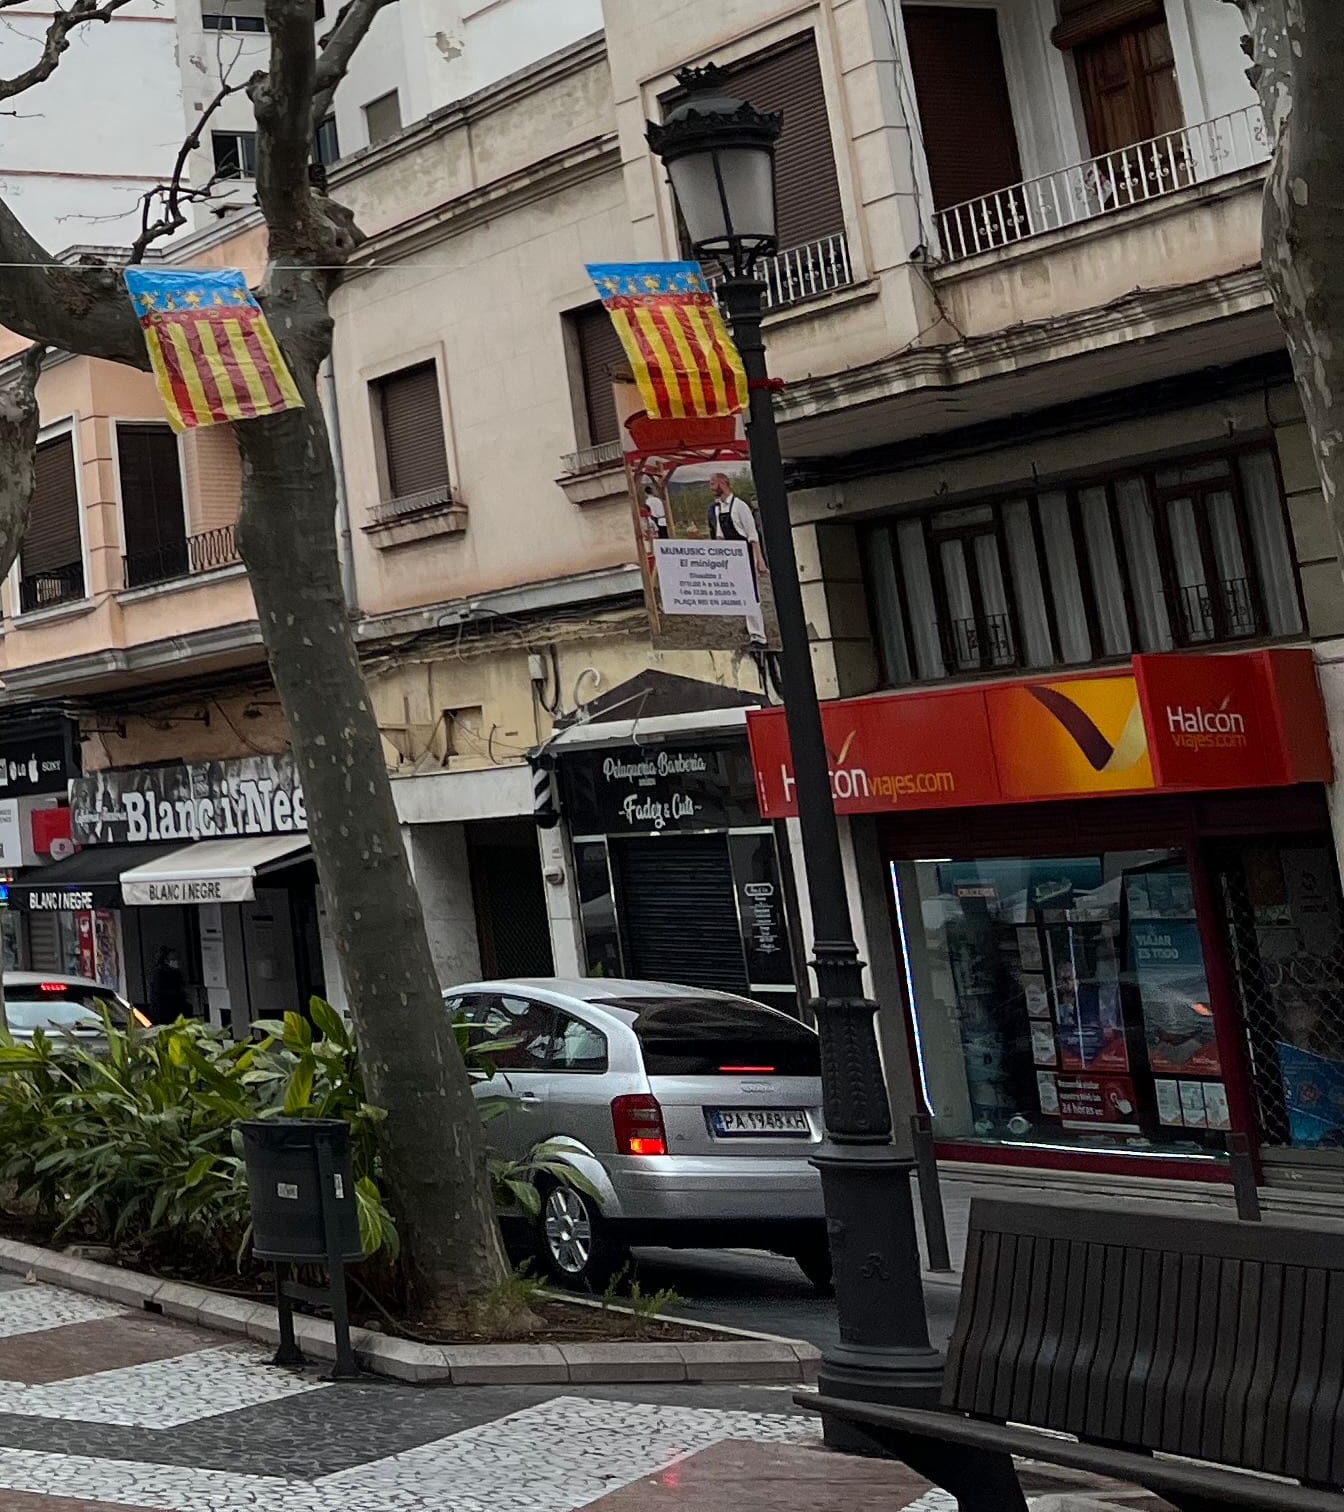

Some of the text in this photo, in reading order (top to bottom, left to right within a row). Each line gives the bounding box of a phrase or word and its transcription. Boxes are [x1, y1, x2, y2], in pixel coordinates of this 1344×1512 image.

[660, 546, 744, 557] MUMUSIC CIRCUS
[680, 558, 728, 570] El minigolf
[1166, 696, 1245, 733] Halcón
[1172, 733, 1247, 752] viajes.com
[17, 763, 27, 776] LG
[41, 760, 61, 772] SONY
[868, 772, 955, 803] viajes.com
[121, 790, 216, 842] Blanc
[29, 891, 93, 910] BLANC I NEGRE
[149, 883, 180, 901] BLANC
[188, 881, 222, 899] NEGRE
